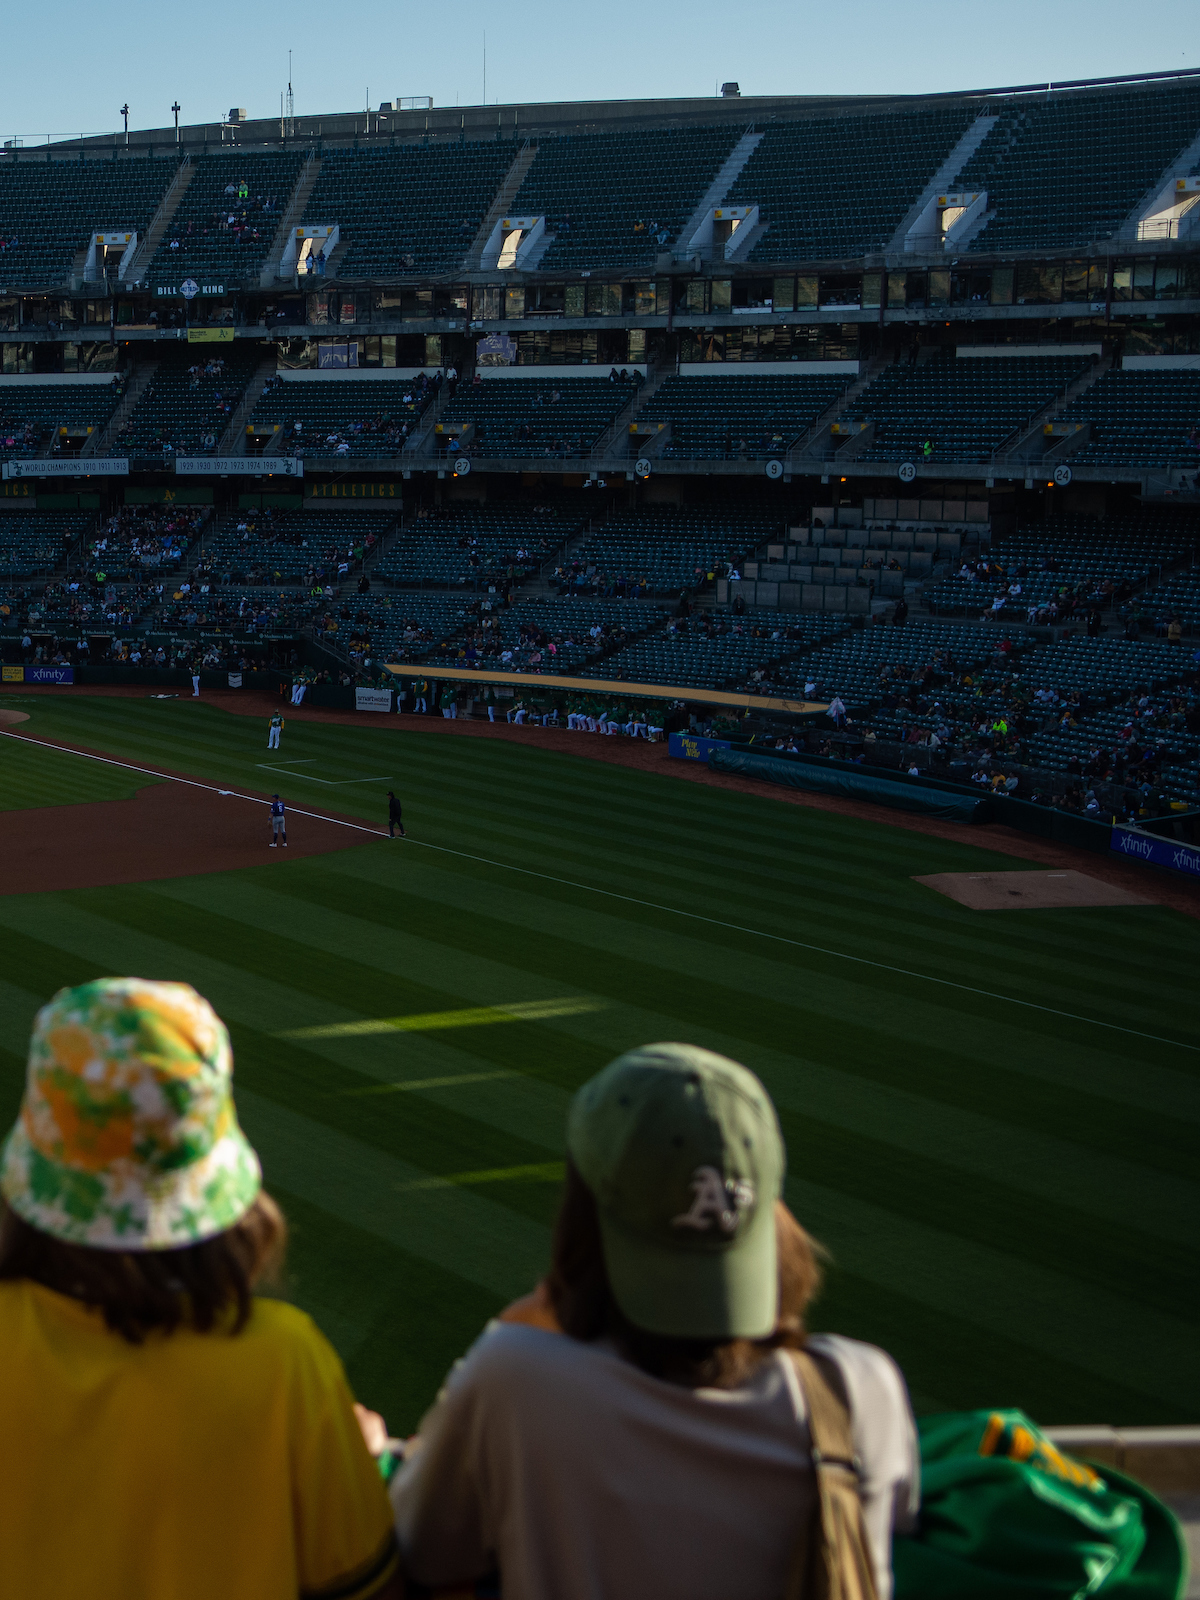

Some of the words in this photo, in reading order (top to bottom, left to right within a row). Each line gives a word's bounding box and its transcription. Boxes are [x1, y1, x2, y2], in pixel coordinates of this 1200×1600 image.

[157, 286, 177, 295] BILL
[202, 285, 224, 294] KING
[25, 464, 46, 472] WORLD
[47, 463, 81, 472] CHAMPIONS
[83, 462, 96, 471] 1910
[98, 462, 111, 471] 1911
[113, 462, 127, 470] 1913
[180, 462, 194, 470] 1929
[196, 462, 211, 470] 1930
[214, 462, 228, 470] 1972
[230, 462, 244, 470] 1973
[247, 462, 261, 470] 1974
[263, 462, 277, 470] 1989
[457, 462, 468, 471] 27
[637, 462, 649, 473] 34
[771, 464, 777, 474] 9
[901, 466, 913, 477] 43
[1057, 469, 1069, 481] 24
[312, 484, 395, 496] ATHLETICS
[32, 668, 65, 681] xfinity
[357, 695, 390, 703] smartwater
[1120, 834, 1154, 859] xfinity
[1172, 848, 1200, 875] xfinit
[670, 1164, 753, 1233] A's
